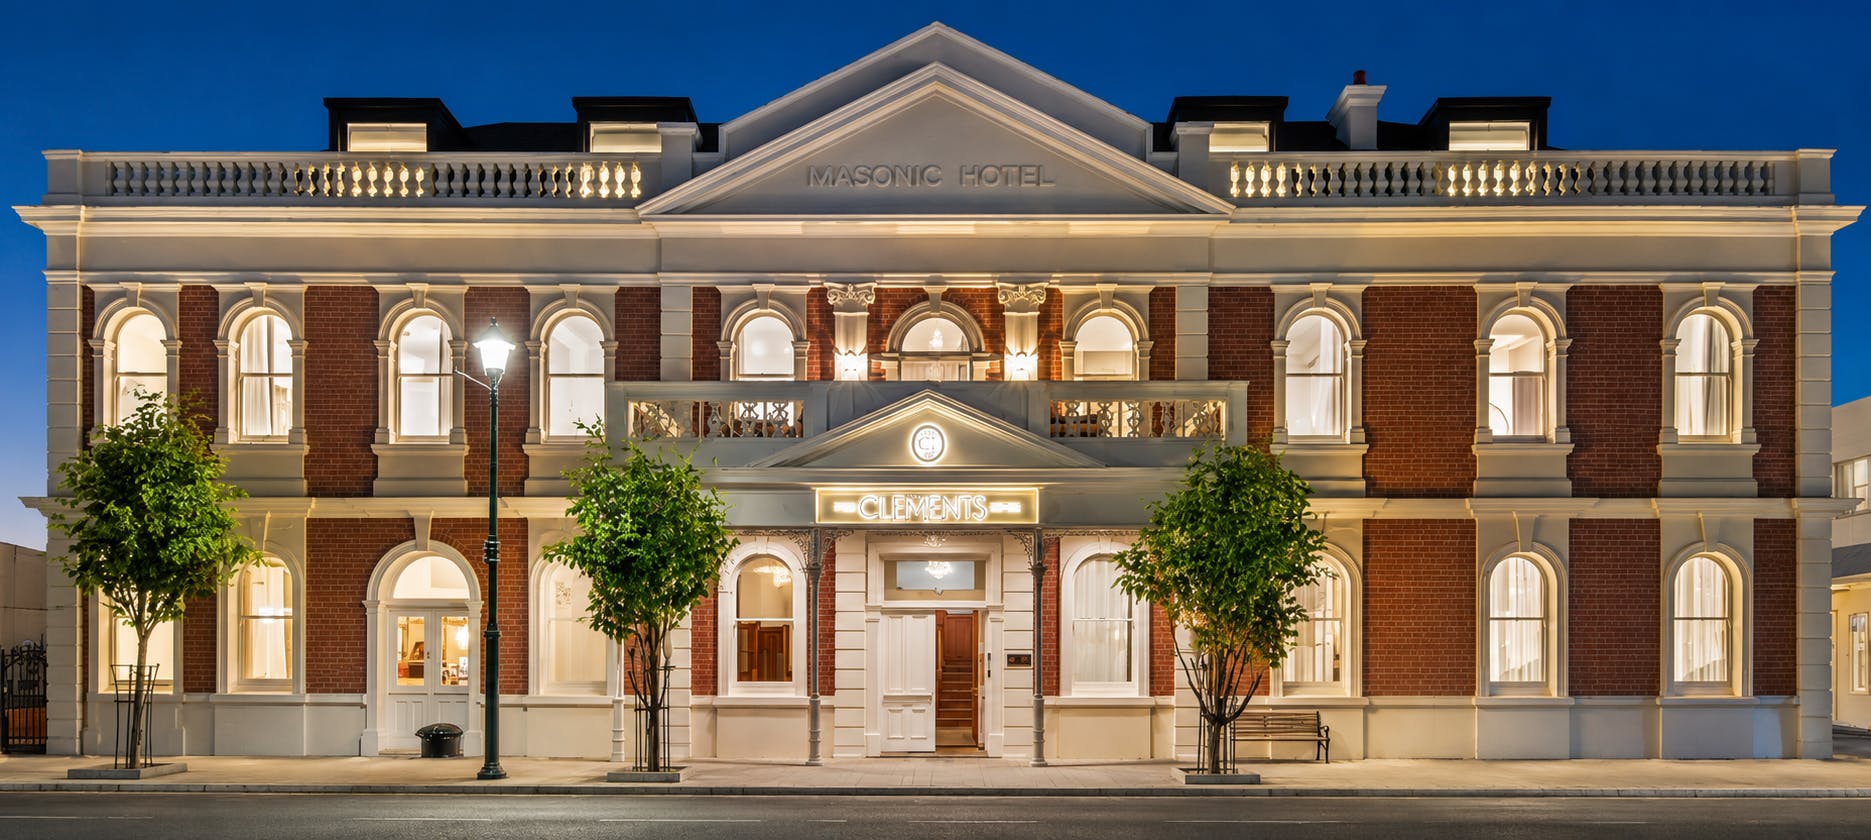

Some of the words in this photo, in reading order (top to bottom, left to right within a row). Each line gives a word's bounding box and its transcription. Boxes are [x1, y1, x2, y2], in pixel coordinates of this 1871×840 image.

[807, 164, 943, 187] MASONIC
[959, 164, 1056, 187] HOTEL
[858, 494, 987, 521] CLEMENTS
